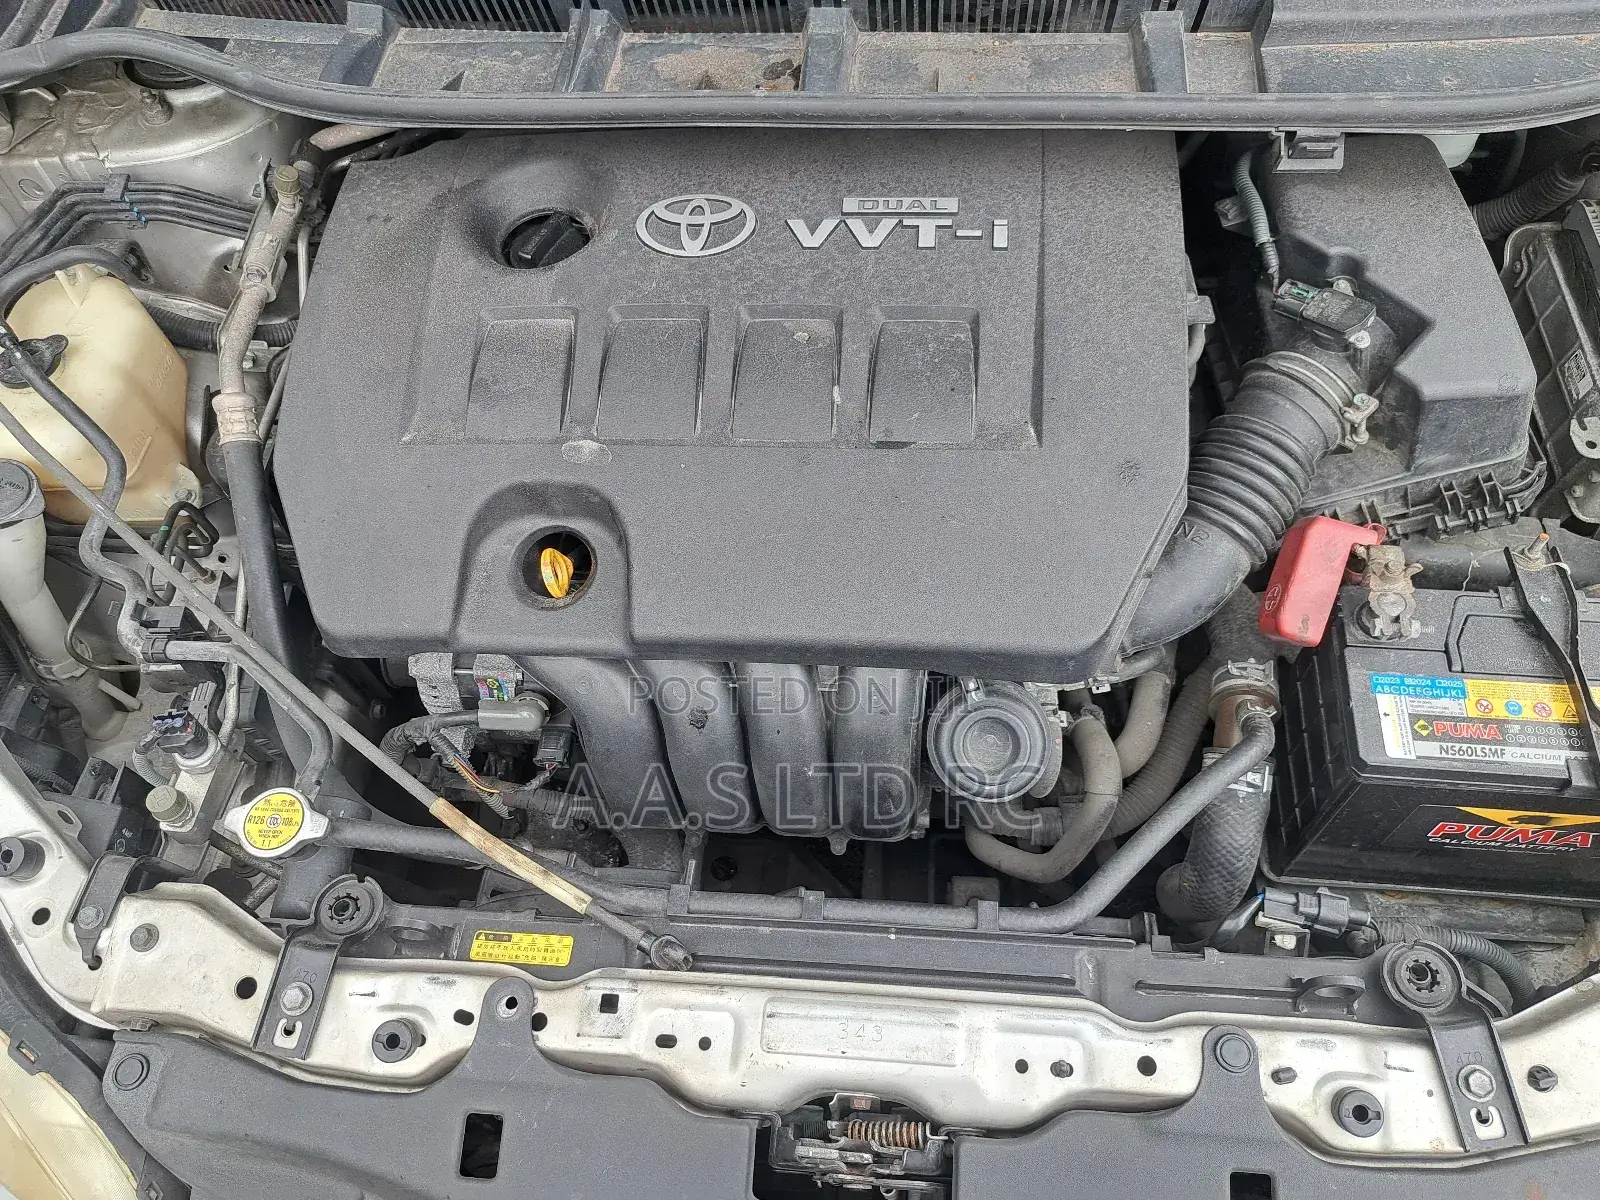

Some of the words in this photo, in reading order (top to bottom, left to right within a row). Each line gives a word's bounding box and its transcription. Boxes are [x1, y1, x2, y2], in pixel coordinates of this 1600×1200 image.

[857, 199, 949, 211] DUAL
[785, 218, 1009, 250] VVT-i
[1379, 676, 1400, 684] 2023
[1412, 678, 1432, 686] 2024
[1442, 680, 1463, 688] 2025
[1375, 685, 1465, 698] ABCDEFGHIJKL
[1433, 720, 1503, 740] PUMA
[1439, 744, 1506, 760] NS60LSMF
[1510, 752, 1561, 761] CALCIUM
[247, 815, 265, 825] R126
[1427, 821, 1593, 848] PUMA
[261, 839, 272, 848] 1.1
[1428, 837, 1501, 847] CALCIUM
[1505, 842, 1580, 852] BATTERY
[837, 1022, 883, 1043] 343
